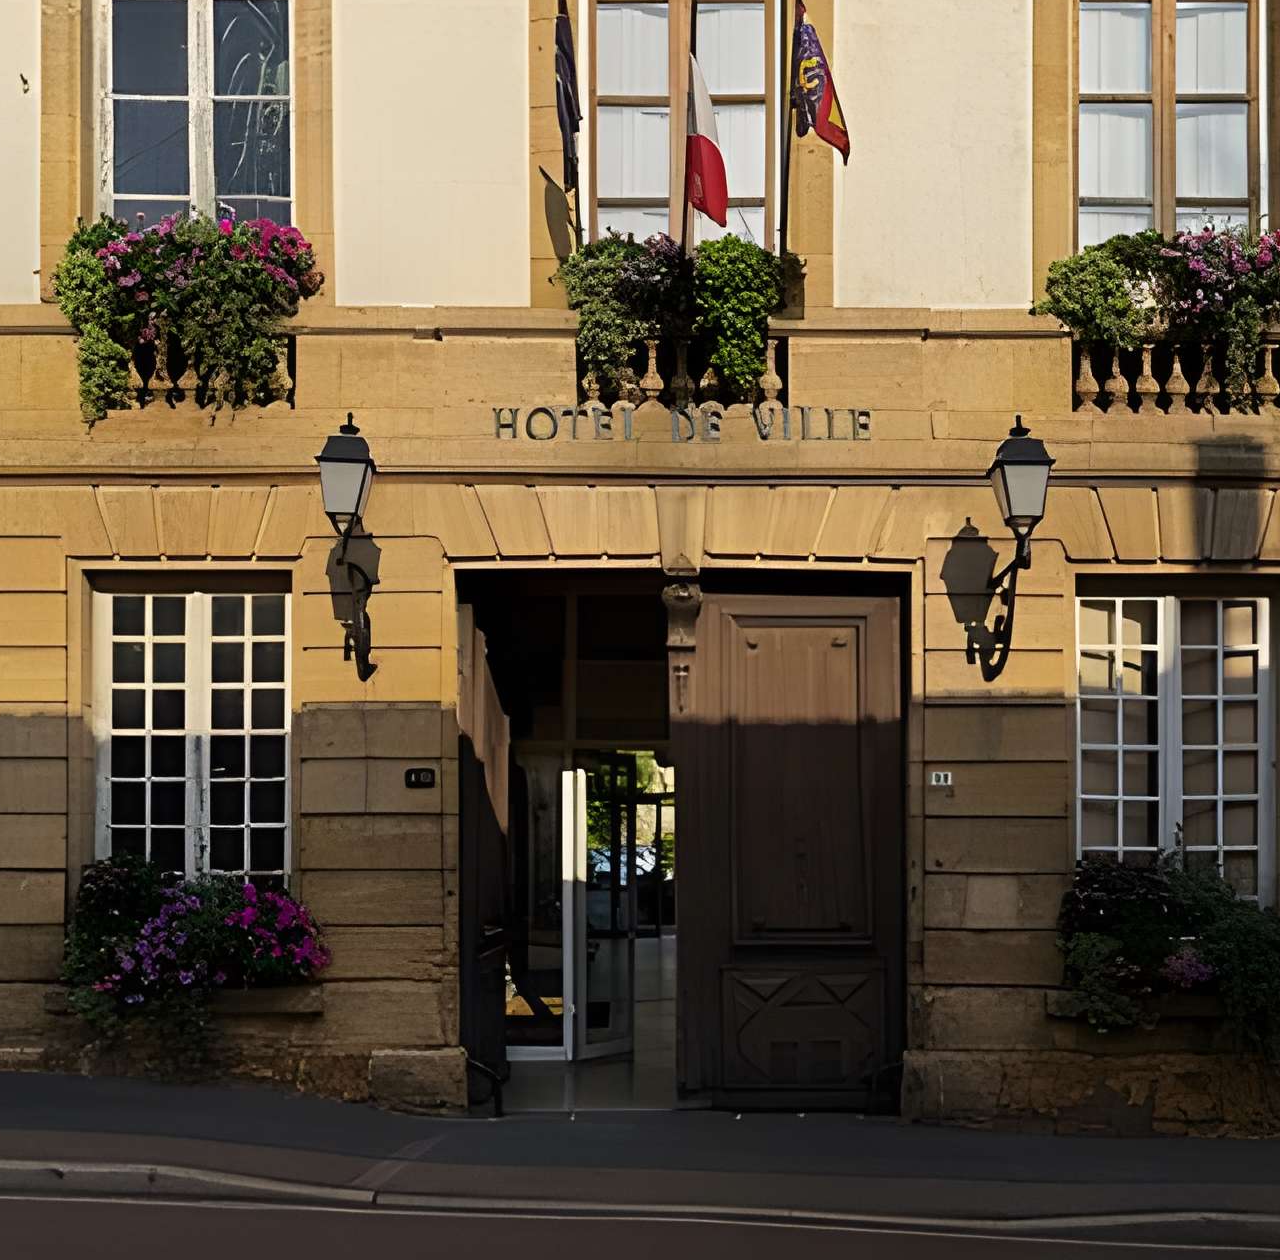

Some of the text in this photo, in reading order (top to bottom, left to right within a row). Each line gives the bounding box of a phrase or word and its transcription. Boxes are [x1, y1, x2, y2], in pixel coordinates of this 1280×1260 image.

[492, 405, 871, 442] HOTEL DE VILLE
